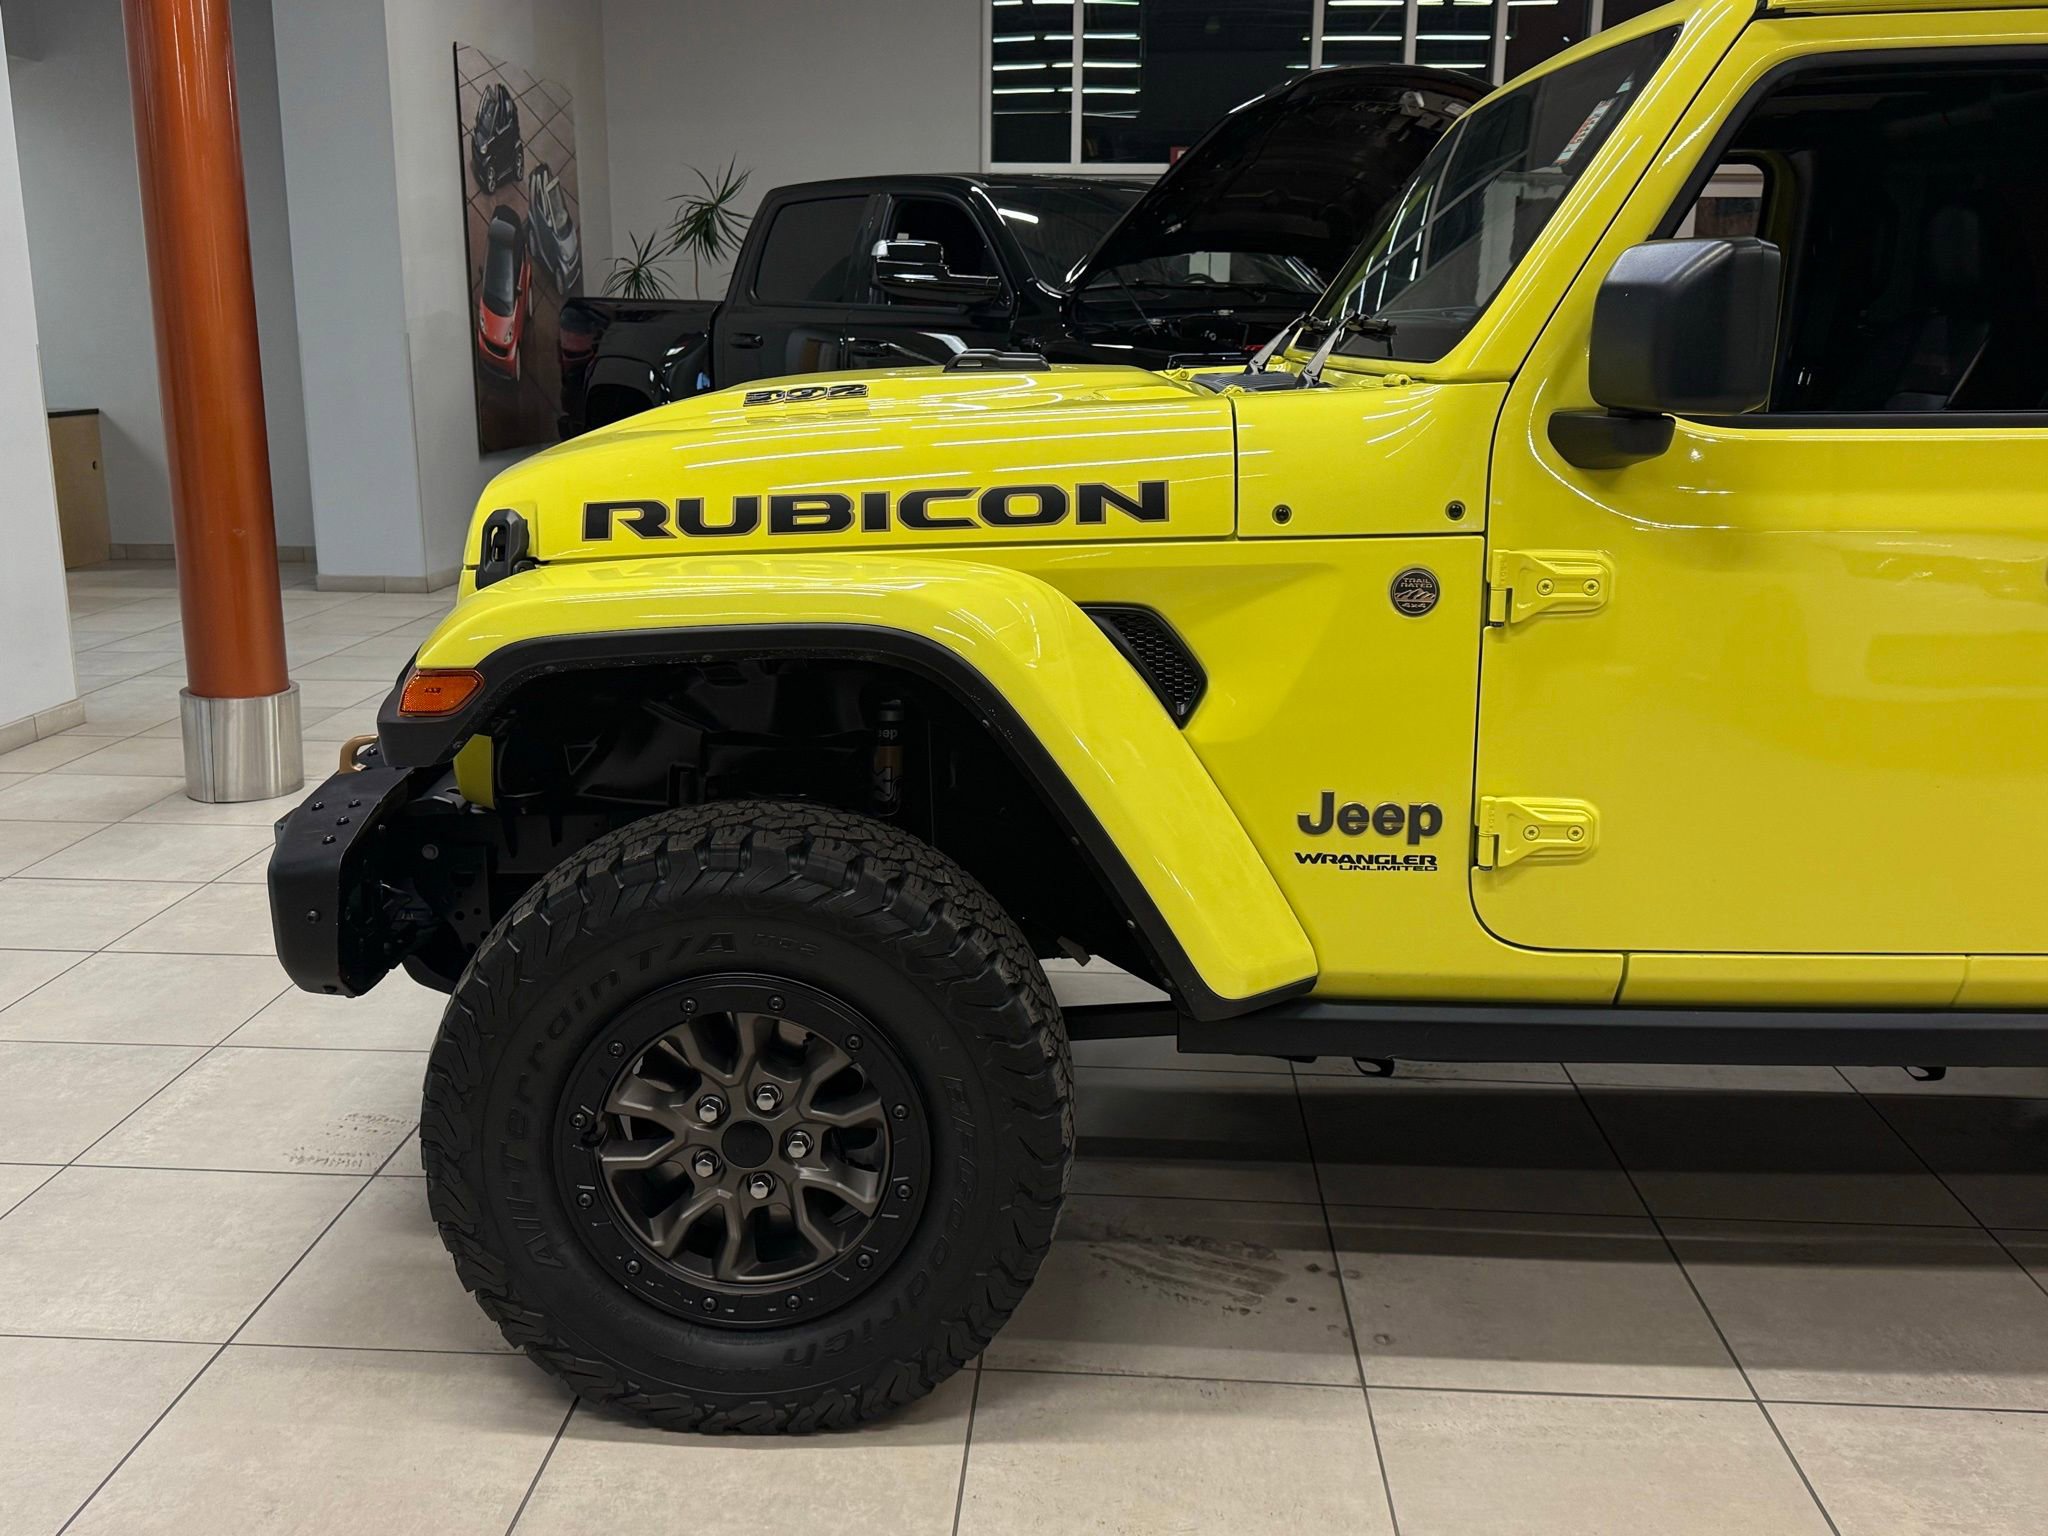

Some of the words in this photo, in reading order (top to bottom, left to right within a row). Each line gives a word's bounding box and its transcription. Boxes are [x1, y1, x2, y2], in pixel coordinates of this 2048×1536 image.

[743, 384, 869, 407] 392
[582, 480, 1171, 542] RUBICON
[1296, 790, 1443, 845] Jeep
[1294, 852, 1438, 865] WRANGLER
